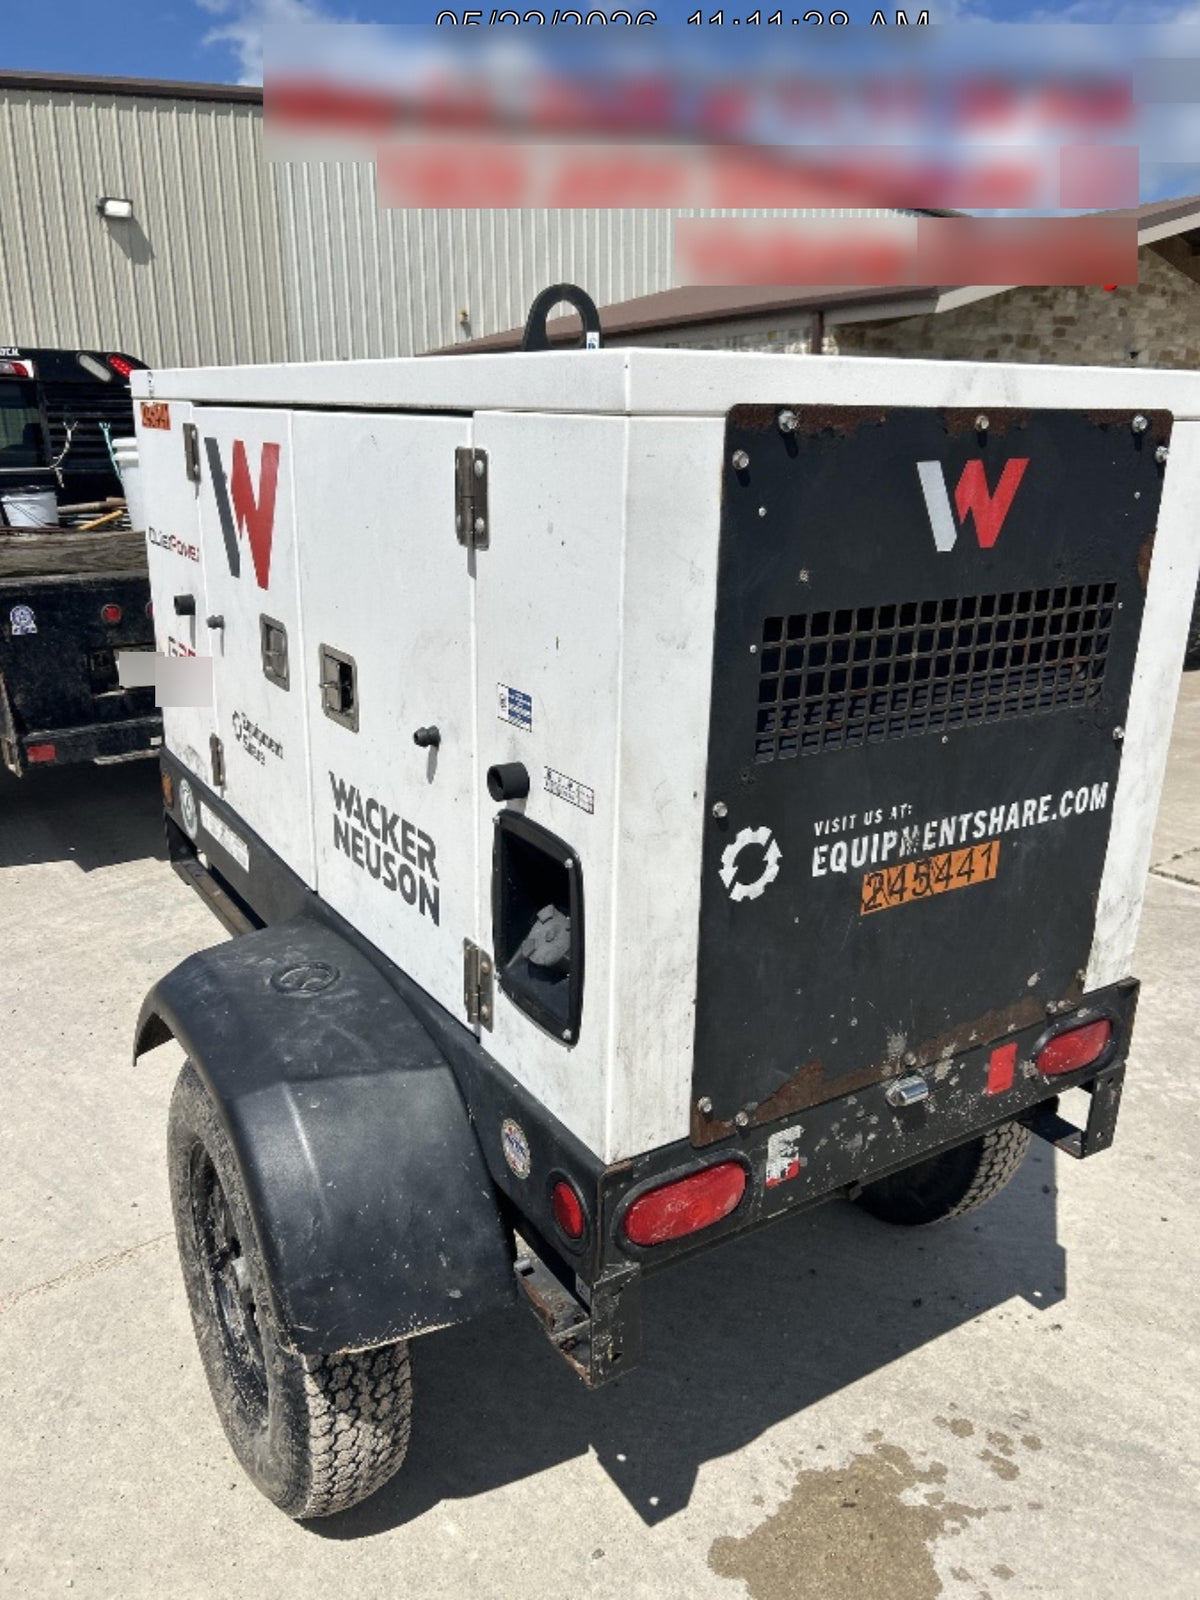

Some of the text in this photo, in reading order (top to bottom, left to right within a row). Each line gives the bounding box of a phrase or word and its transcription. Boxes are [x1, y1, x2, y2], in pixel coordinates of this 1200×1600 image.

[328, 769, 440, 883] WACKER
[812, 782, 1109, 877] EQUIPMENTSHARE.COM
[813, 803, 913, 836] VISIT US AT:
[333, 813, 440, 927] NEUSON
[861, 842, 995, 911] 245441
